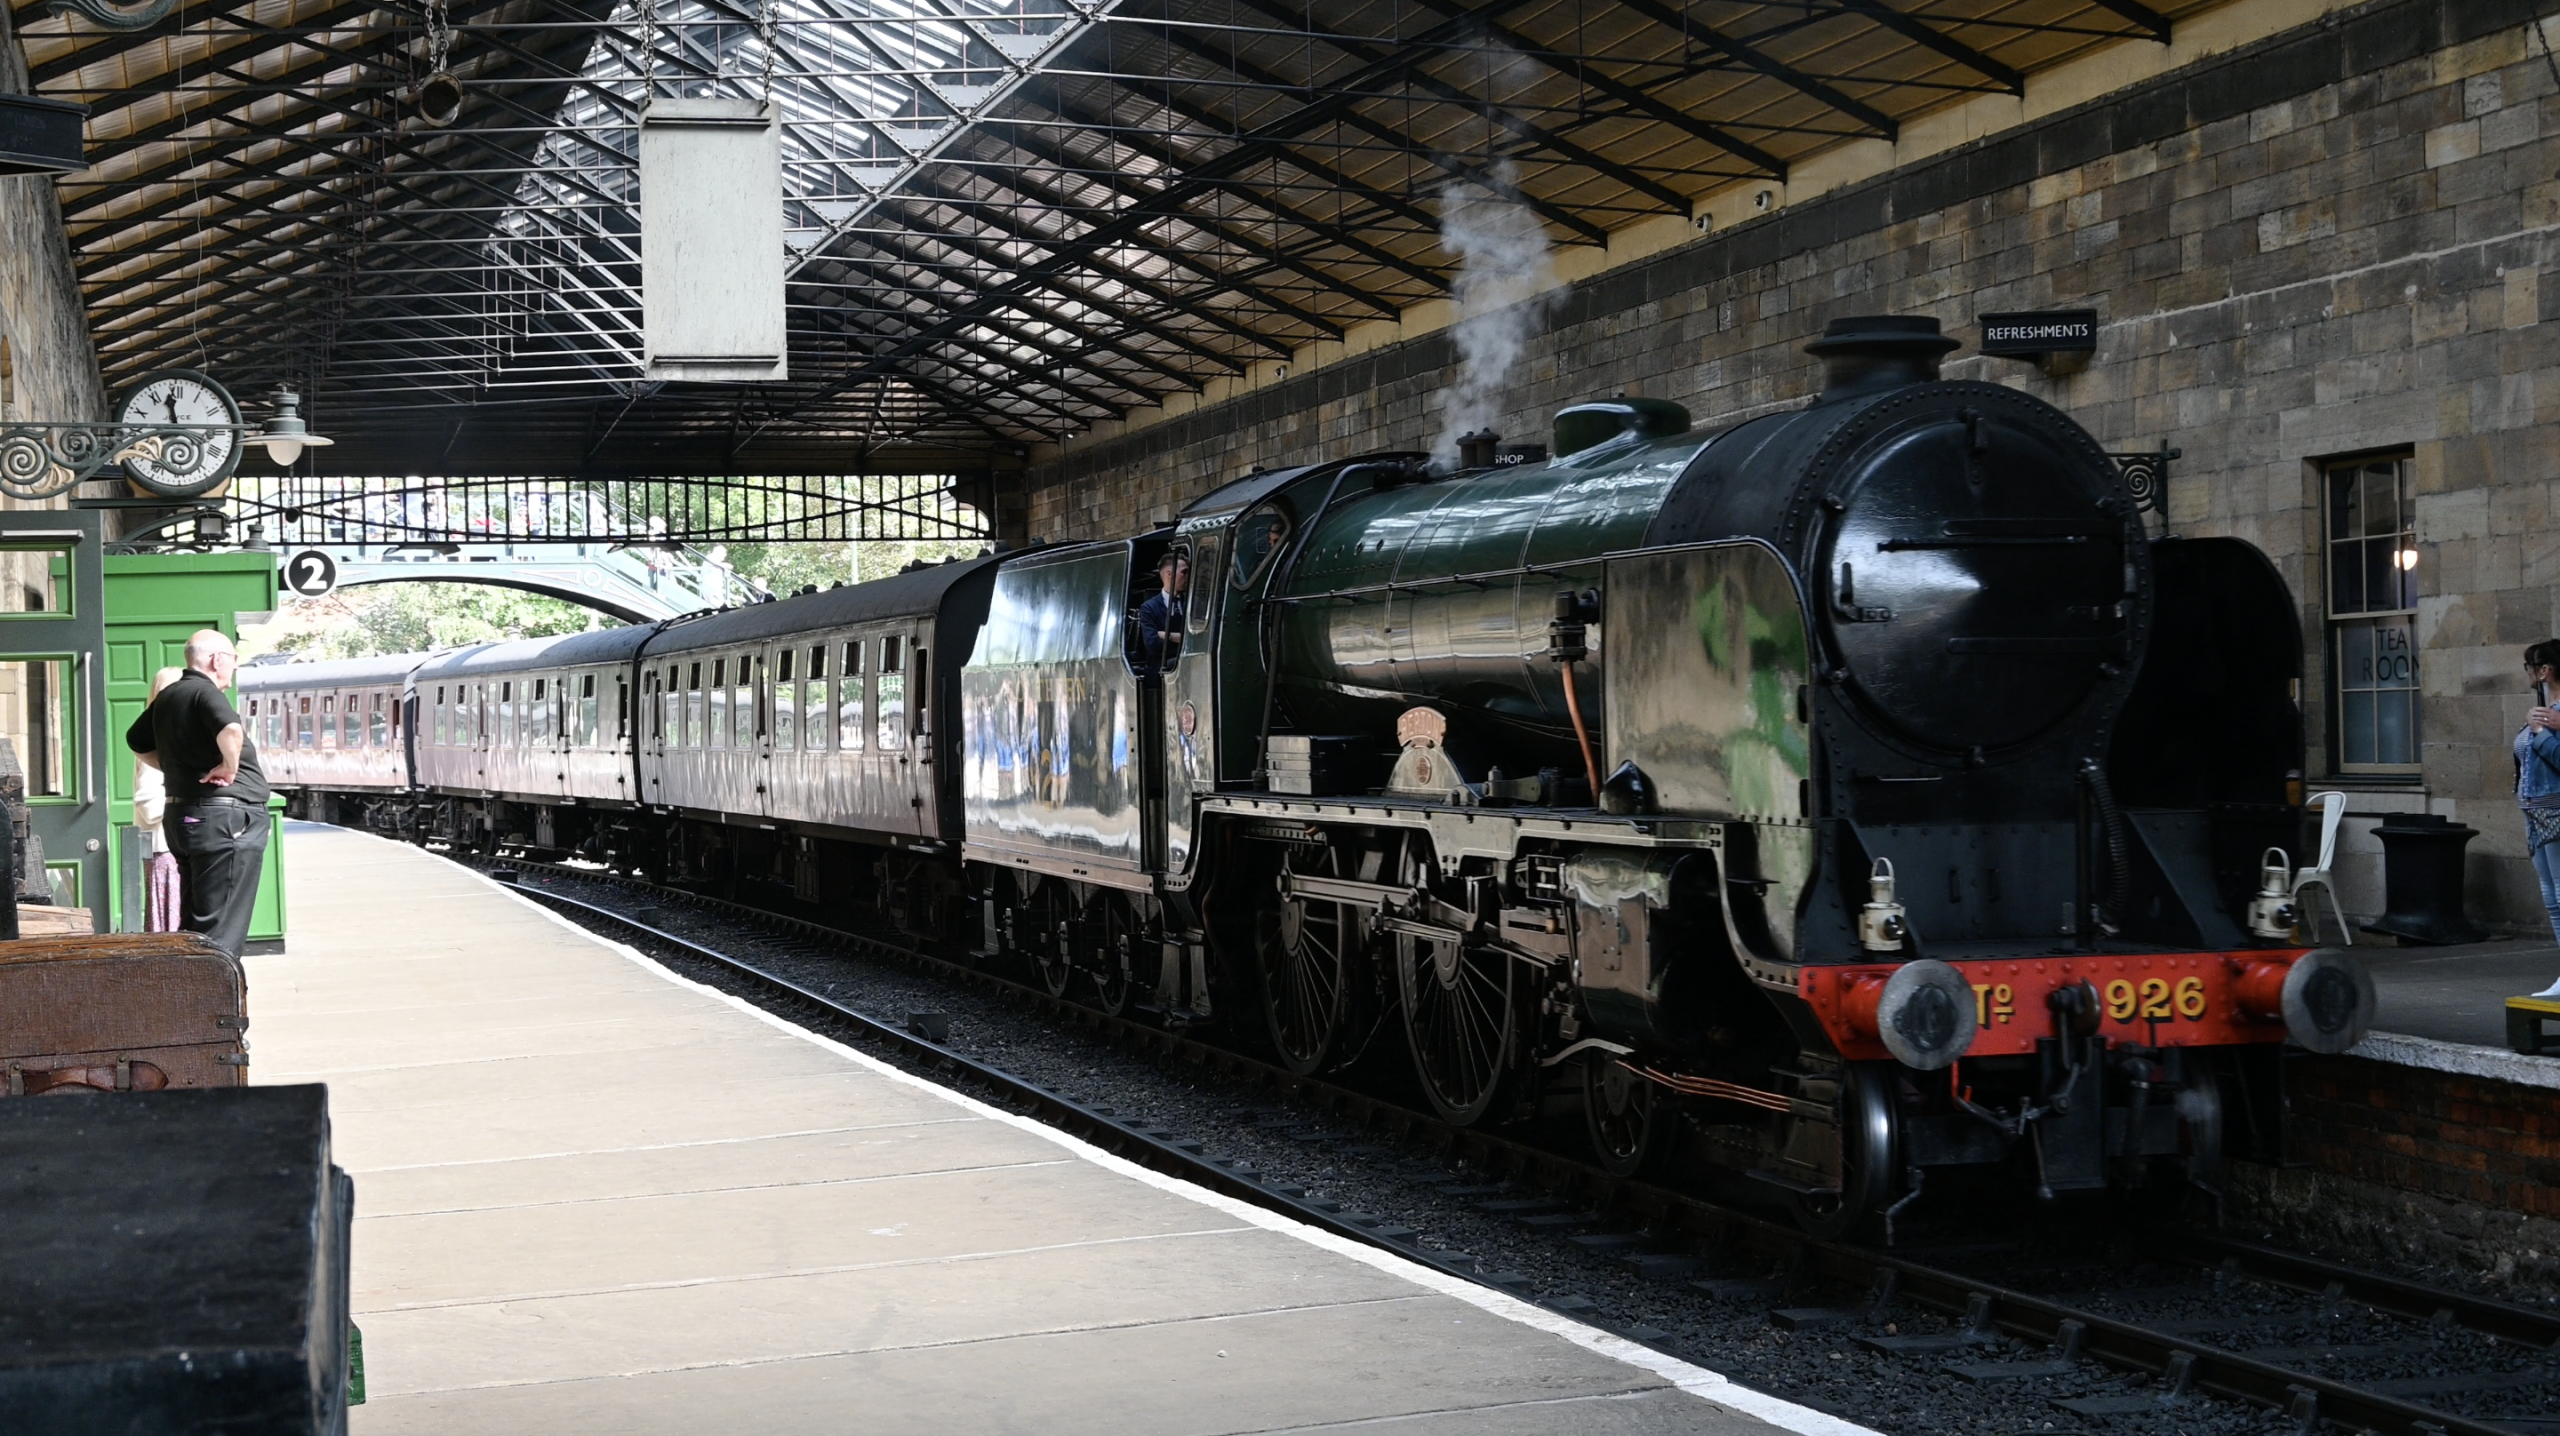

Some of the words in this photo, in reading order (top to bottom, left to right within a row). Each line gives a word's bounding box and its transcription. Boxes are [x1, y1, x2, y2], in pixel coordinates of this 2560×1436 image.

[1988, 323, 2088, 340] REFRESHMENTS
[301, 557, 328, 589] 2
[2376, 628, 2408, 651] TEA
[2105, 976, 2206, 1019] 926
